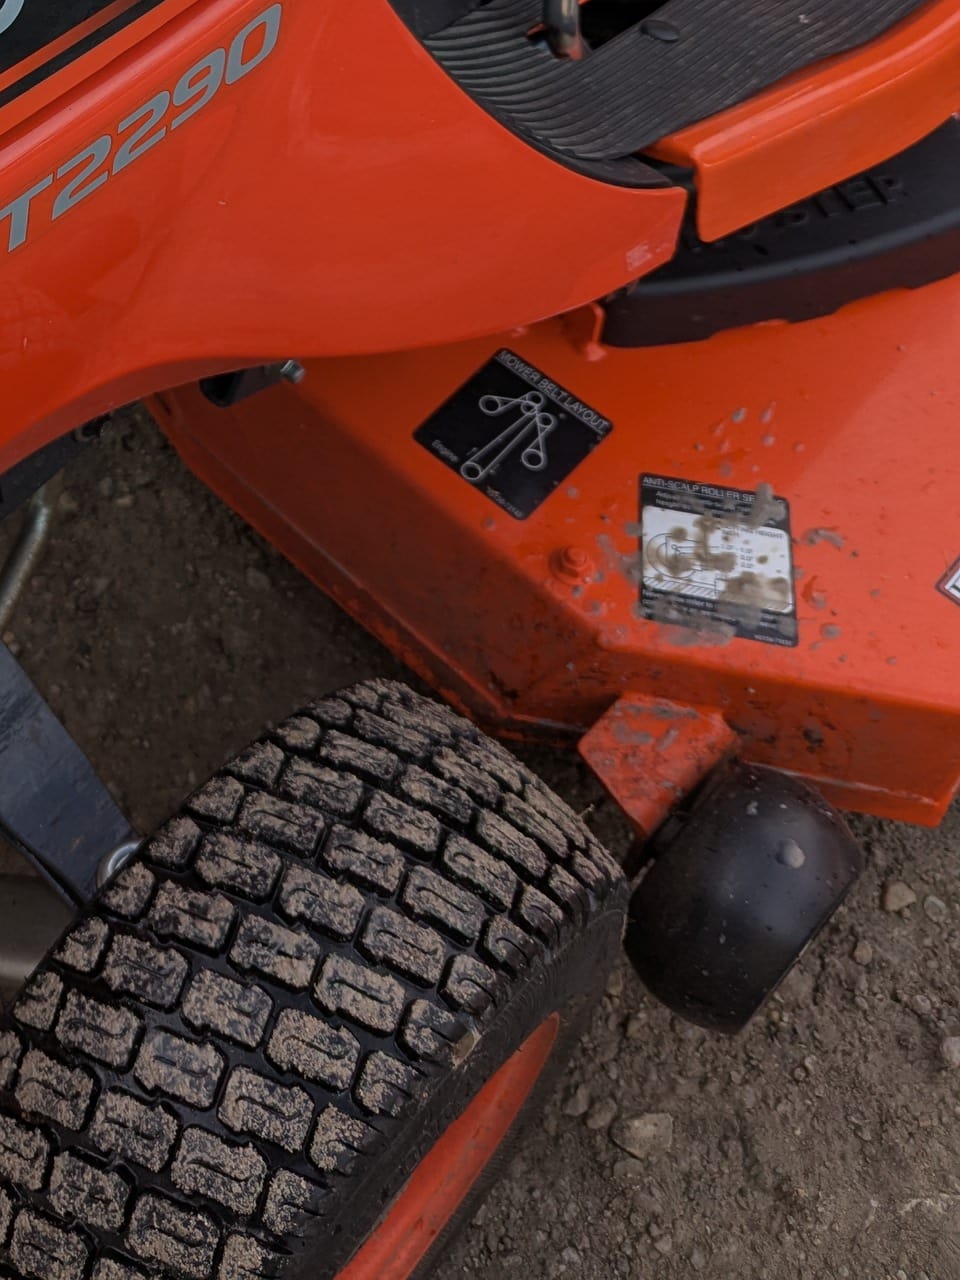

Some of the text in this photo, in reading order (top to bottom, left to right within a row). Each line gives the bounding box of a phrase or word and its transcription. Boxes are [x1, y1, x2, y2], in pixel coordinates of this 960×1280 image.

[499, 348, 612, 430] MOWER BELT LAYOUT
[643, 476, 700, 492] ANTI-SCALP
